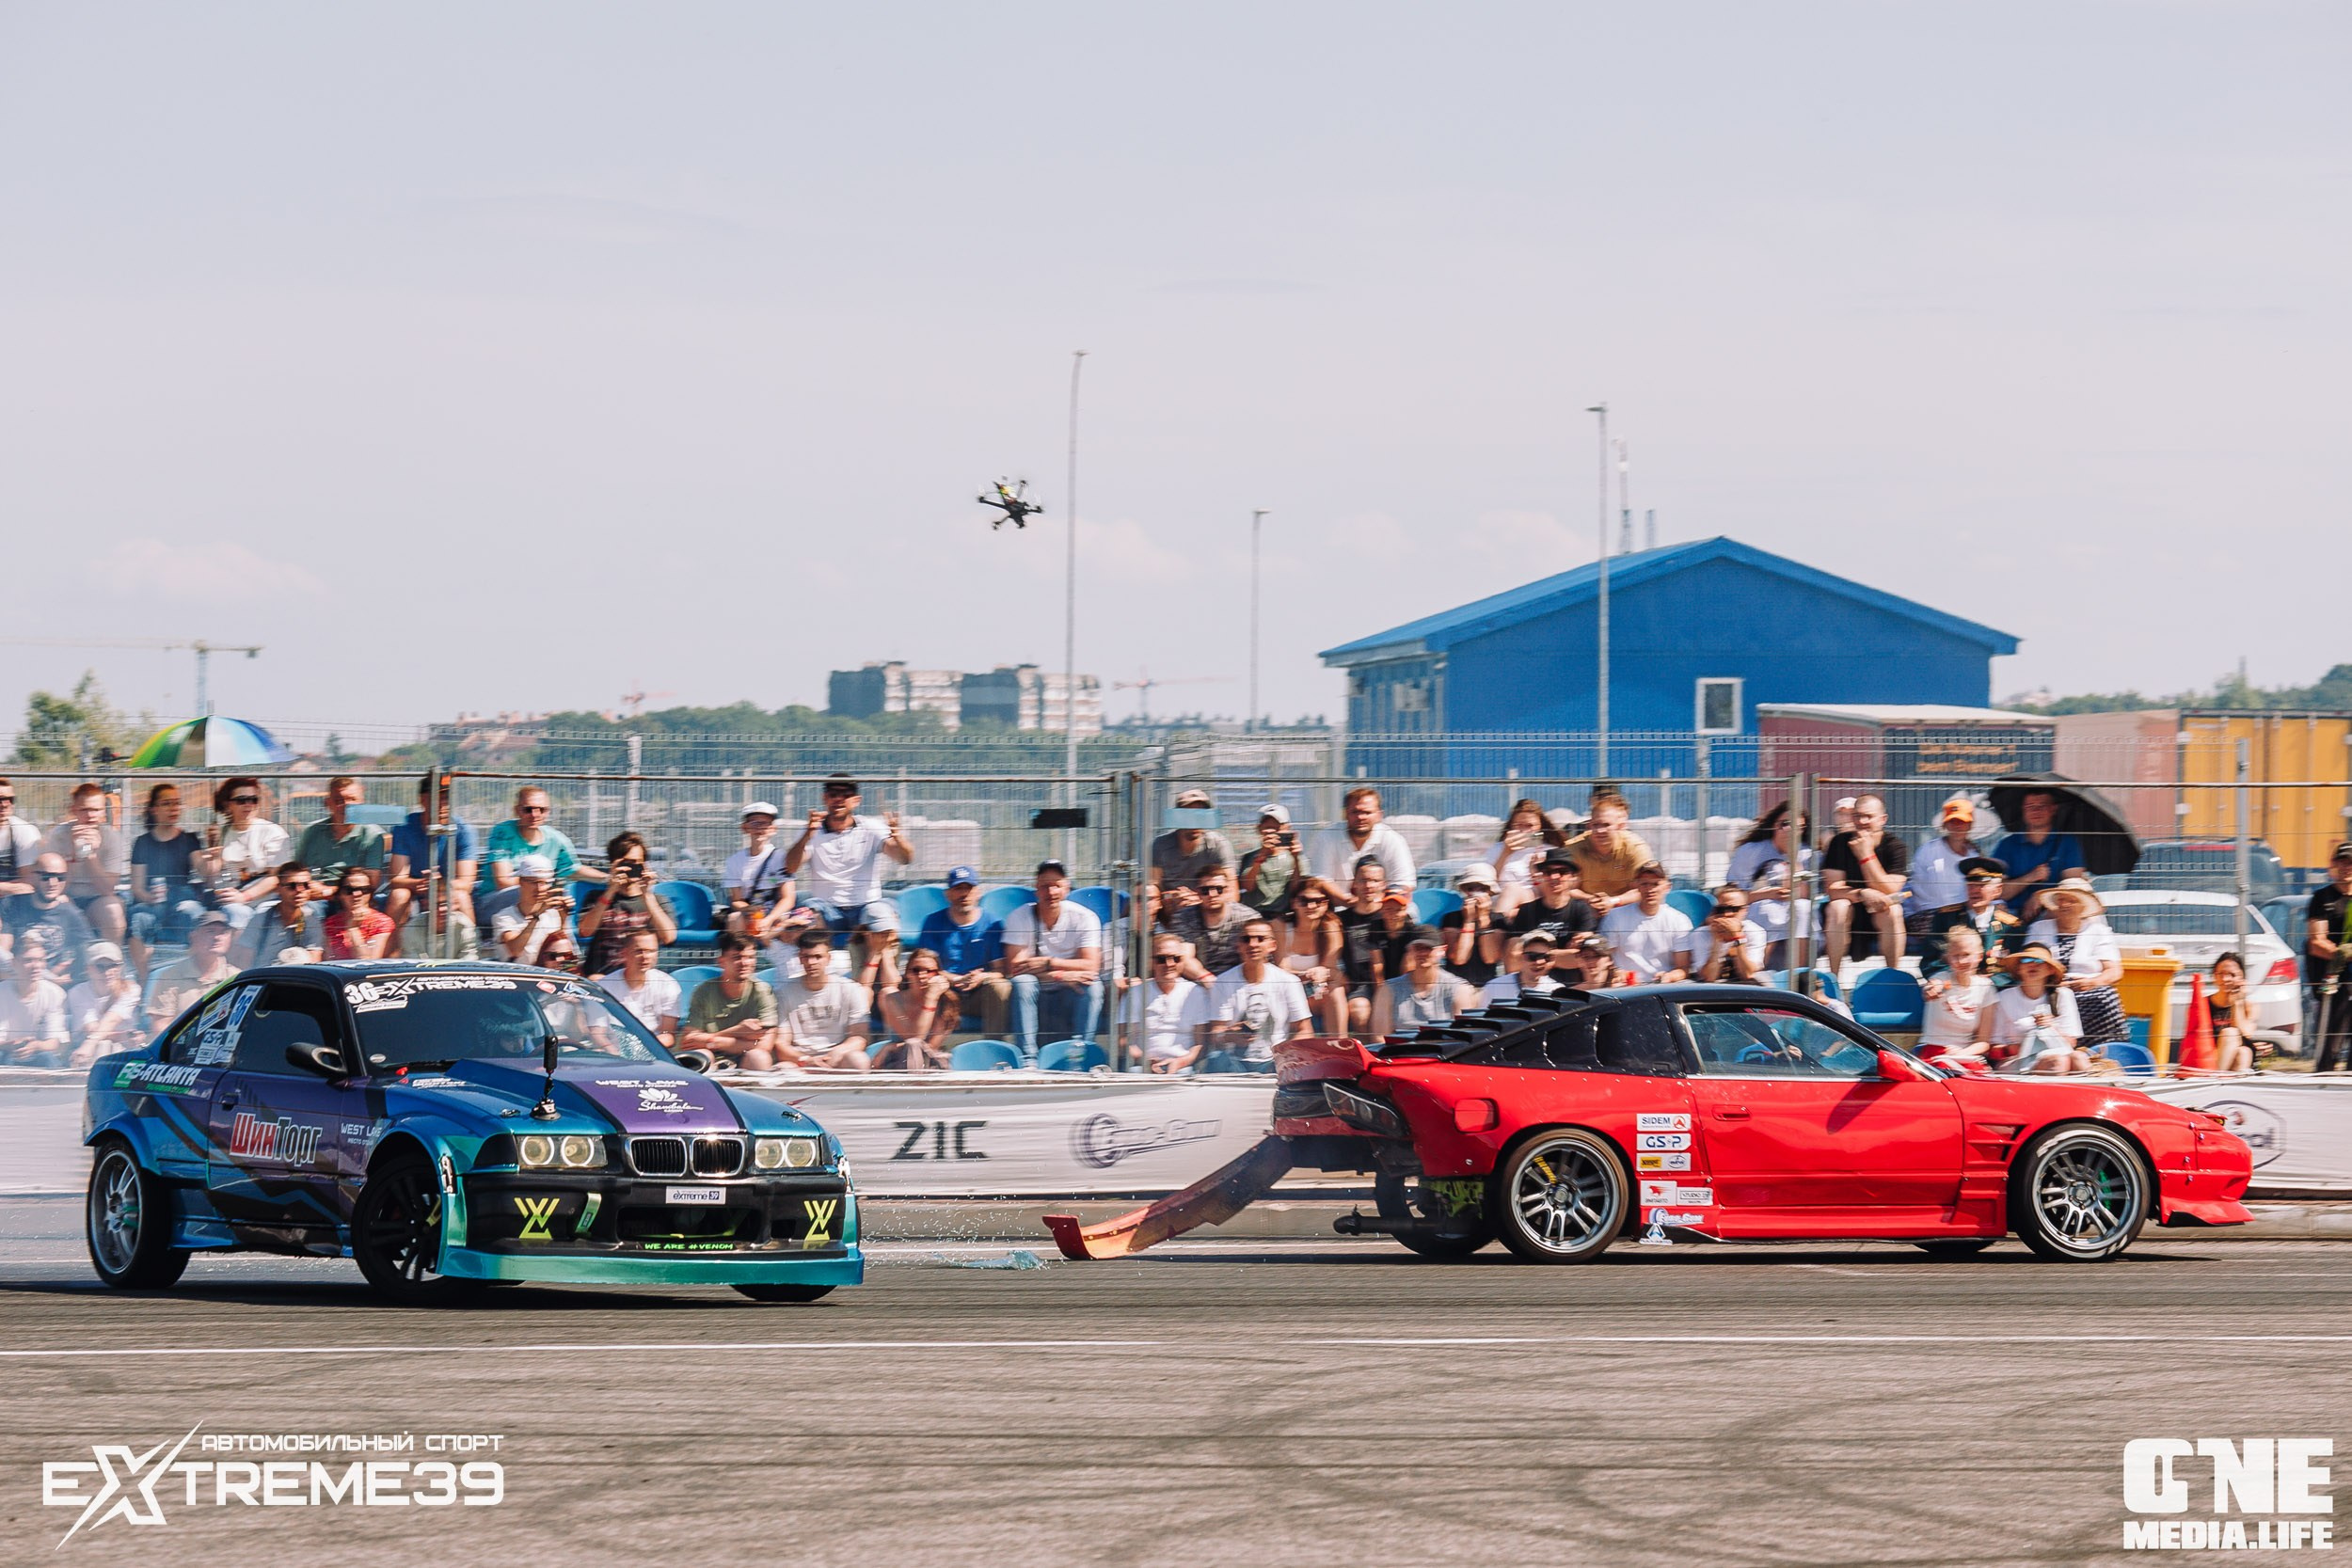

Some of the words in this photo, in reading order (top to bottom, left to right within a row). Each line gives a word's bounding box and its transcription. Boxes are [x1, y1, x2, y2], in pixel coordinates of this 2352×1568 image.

[344, 982, 380, 1005] 36
[229, 994, 254, 1026] 36
[341, 1123, 364, 1135] WEST
[1642, 1117, 1671, 1125] SIDEM
[230, 1113, 323, 1167] ШинТорг
[888, 1120, 991, 1161] ZIC
[709, 1191, 720, 1200] 39
